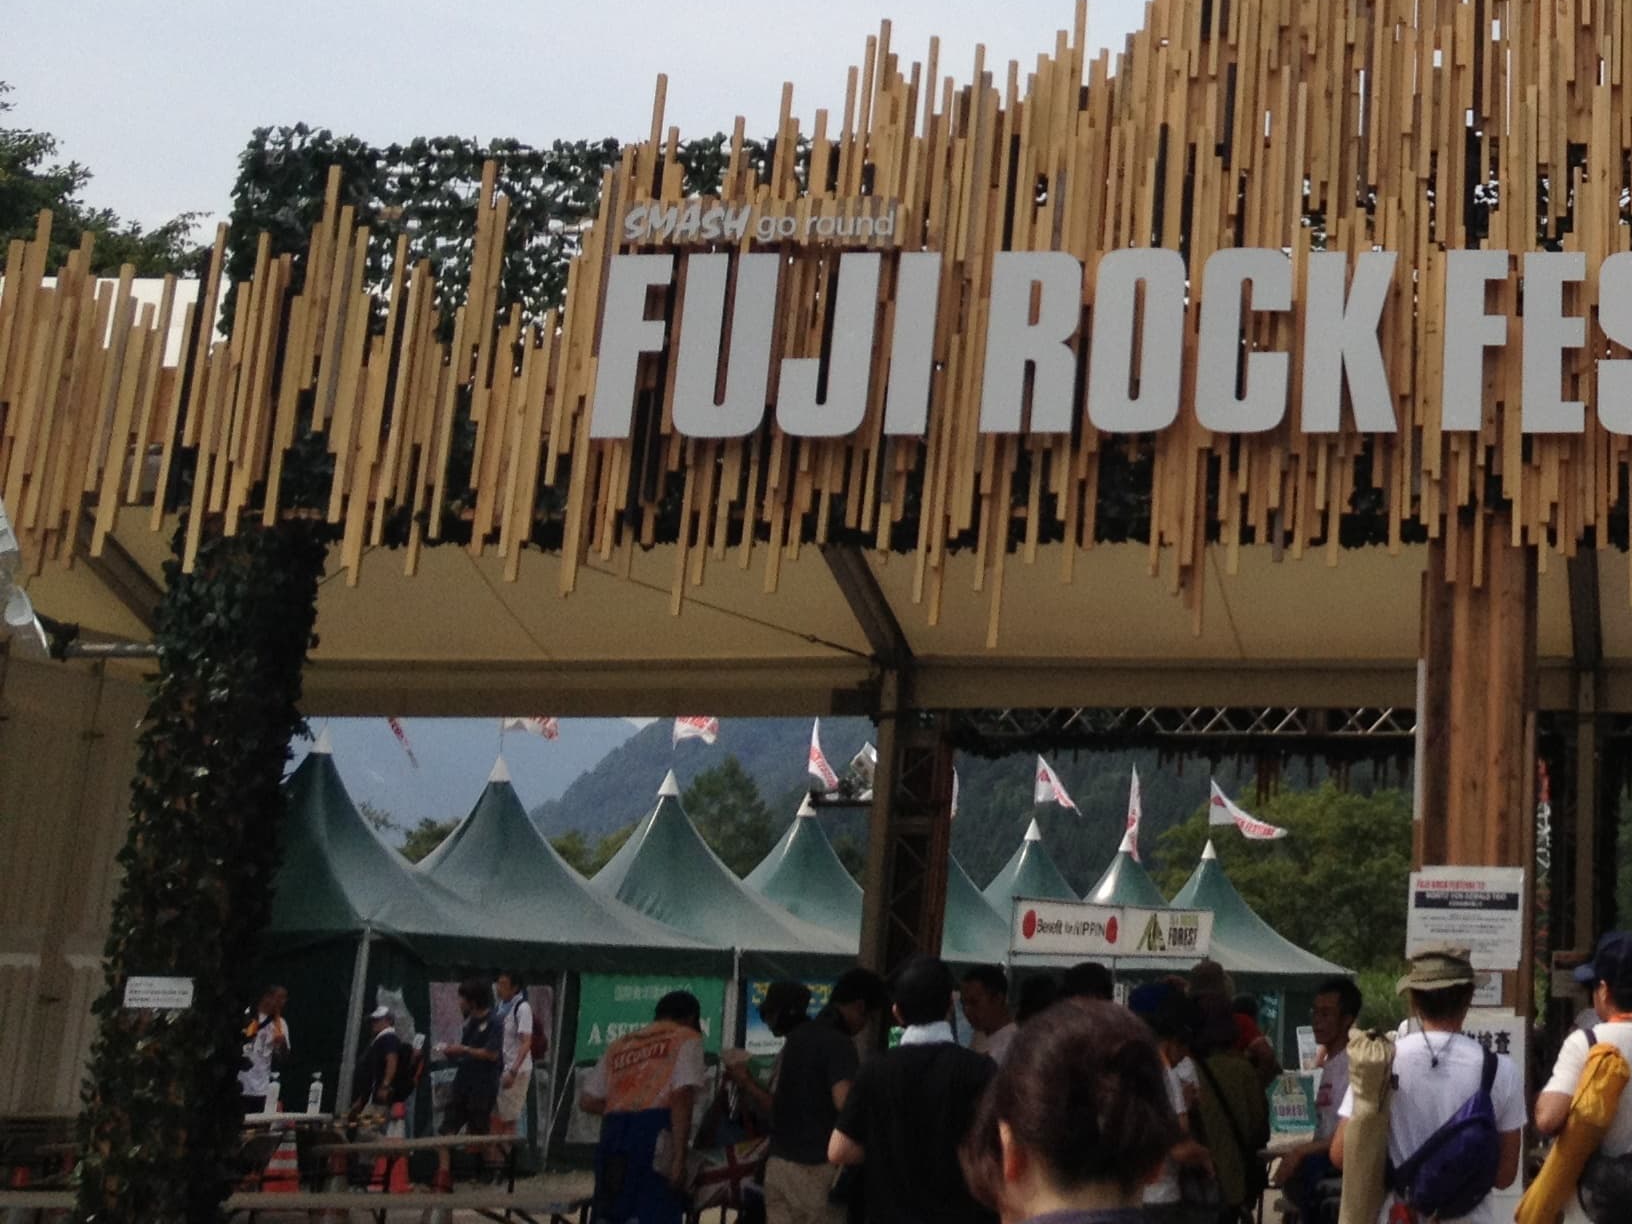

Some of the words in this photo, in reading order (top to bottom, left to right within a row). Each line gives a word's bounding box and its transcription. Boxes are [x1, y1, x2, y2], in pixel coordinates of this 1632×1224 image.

[624, 204, 752, 241] SMASH
[756, 214, 797, 243] go
[804, 209, 896, 237] round
[589, 251, 942, 440] FUJI
[979, 247, 1399, 435] ROCK
[1036, 918, 1063, 935] Benefit
